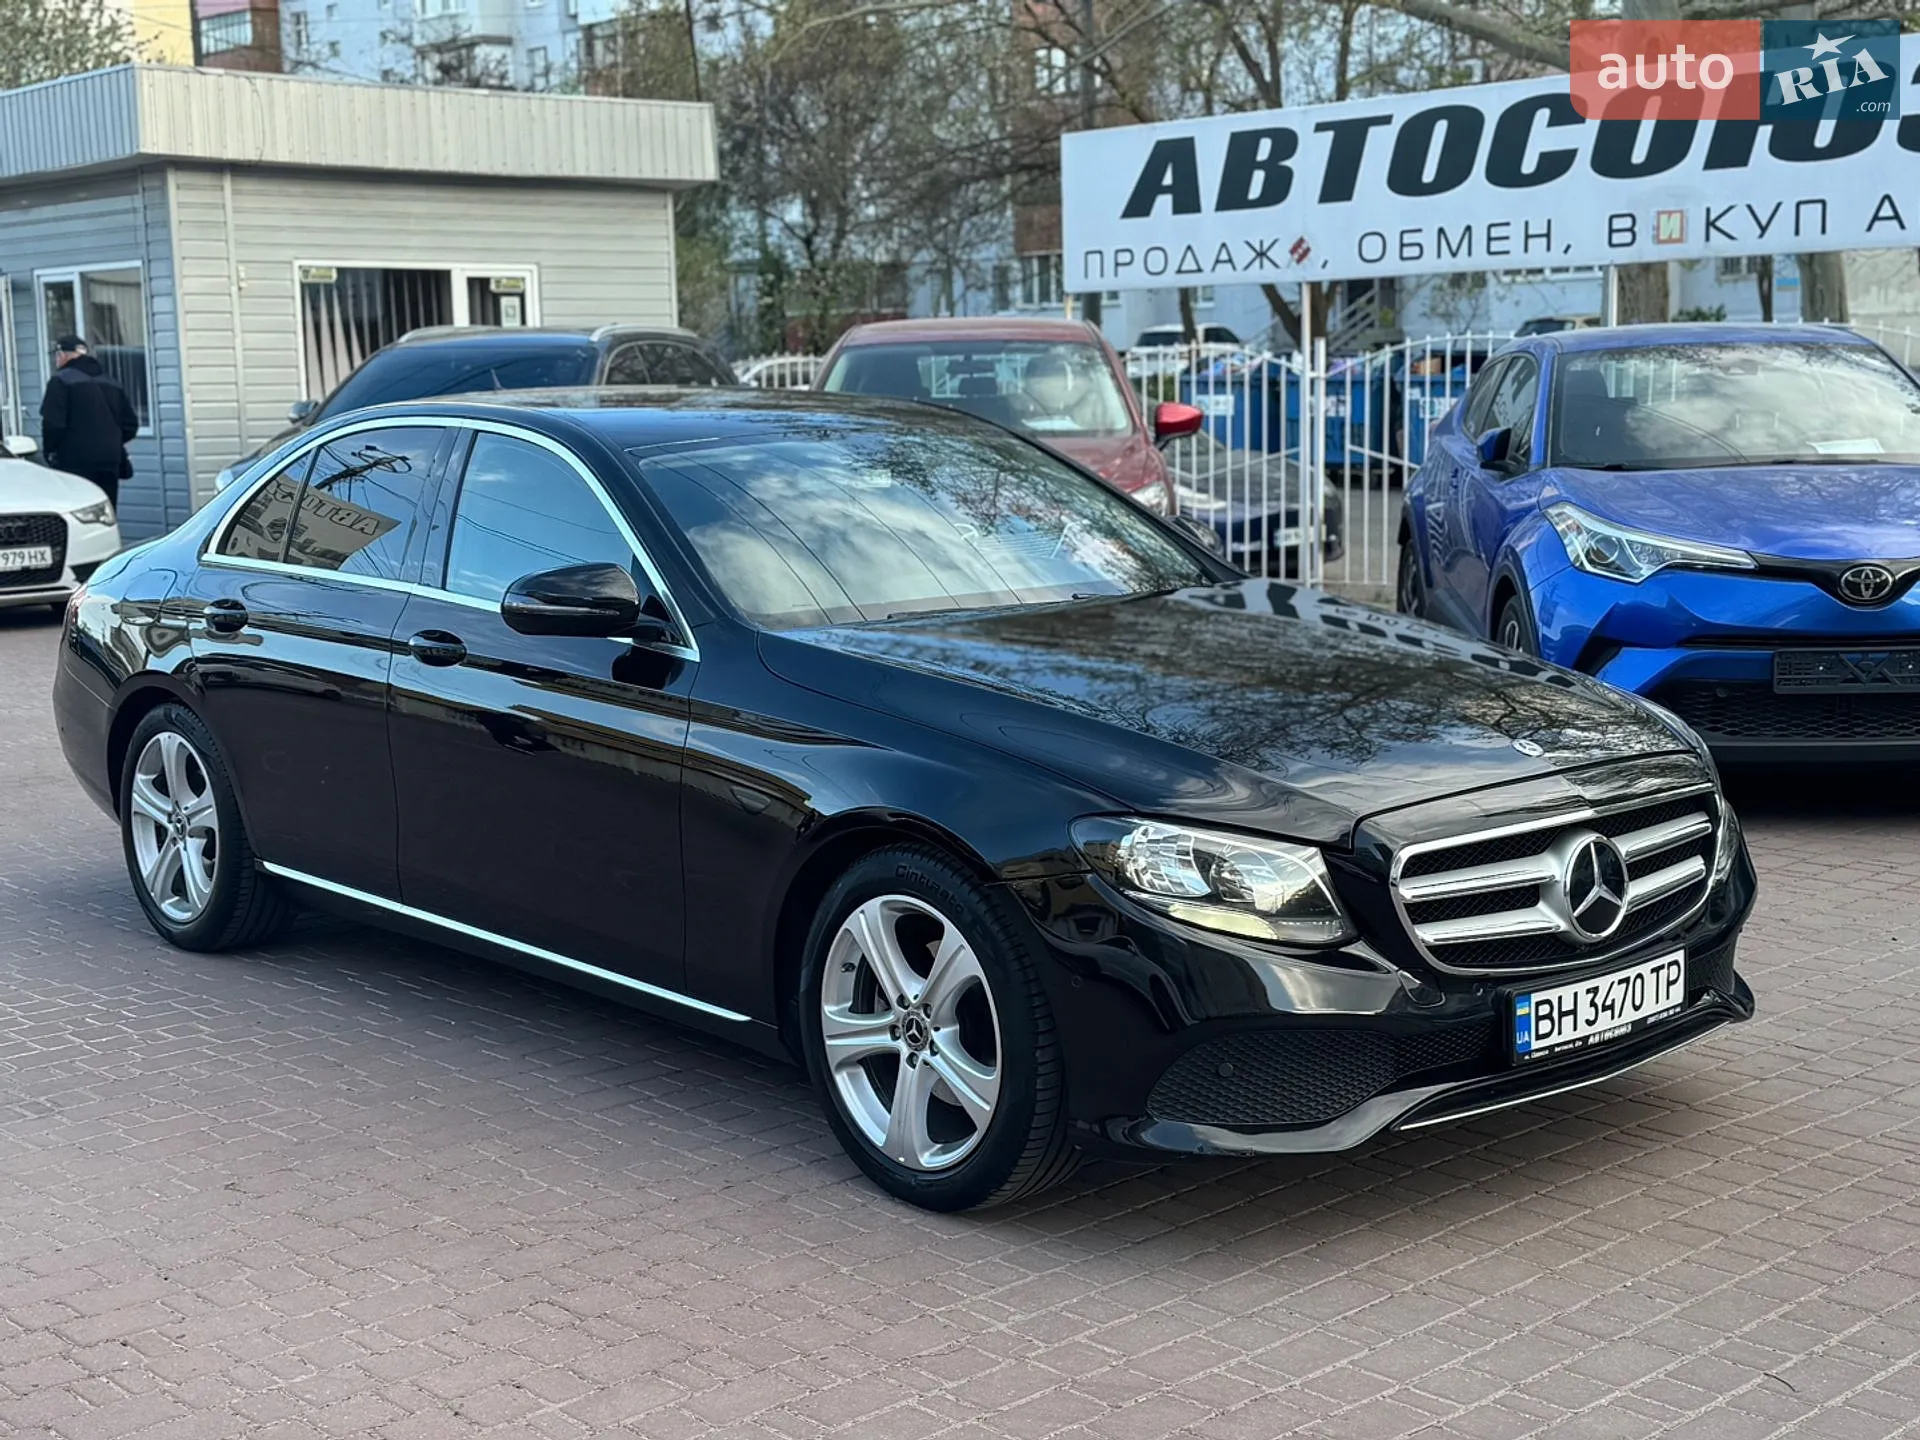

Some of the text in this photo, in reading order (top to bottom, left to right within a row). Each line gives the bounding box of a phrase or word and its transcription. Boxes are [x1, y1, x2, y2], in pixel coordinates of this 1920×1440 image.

[1120, 57, 1920, 219] АВТОСОЮ
[1358, 216, 1572, 264] ОБМЕН,
[1, 551, 25, 570] 979
[28, 549, 47, 565] HX
[1534, 958, 1682, 1042] BH 3470 TP
[1516, 1031, 1530, 1044] UA
